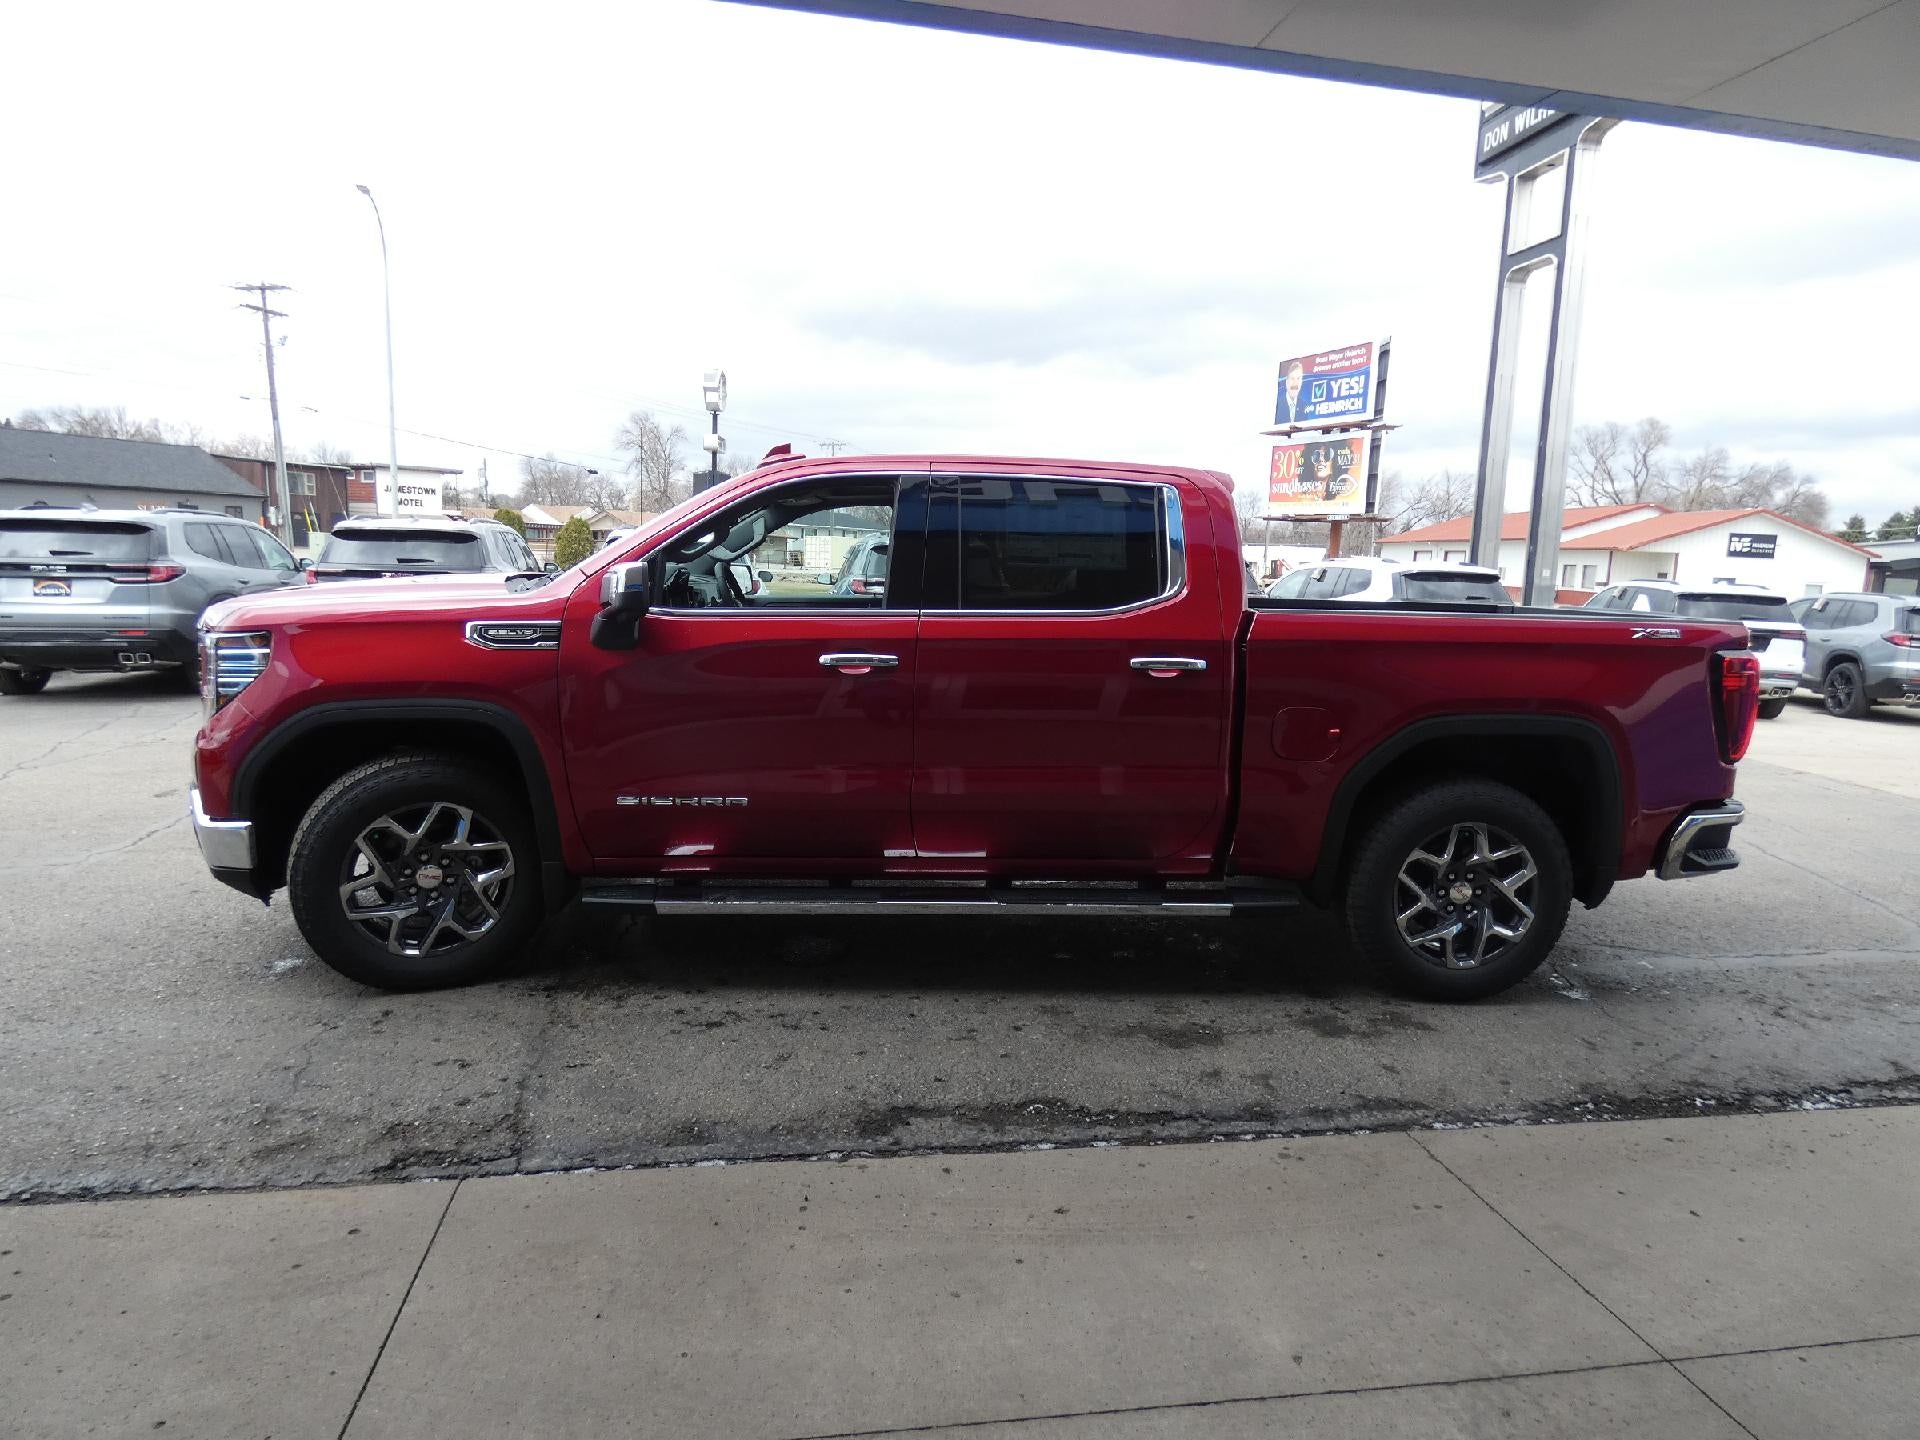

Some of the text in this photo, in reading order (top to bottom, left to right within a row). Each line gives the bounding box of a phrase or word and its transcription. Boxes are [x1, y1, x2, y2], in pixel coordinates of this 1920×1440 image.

[1483, 121, 1509, 152] DON
[1330, 375, 1366, 398] YES!
[1315, 397, 1363, 415] HEINRICH
[1273, 449, 1304, 479] 30%
[616, 796, 747, 807] SIERRA
